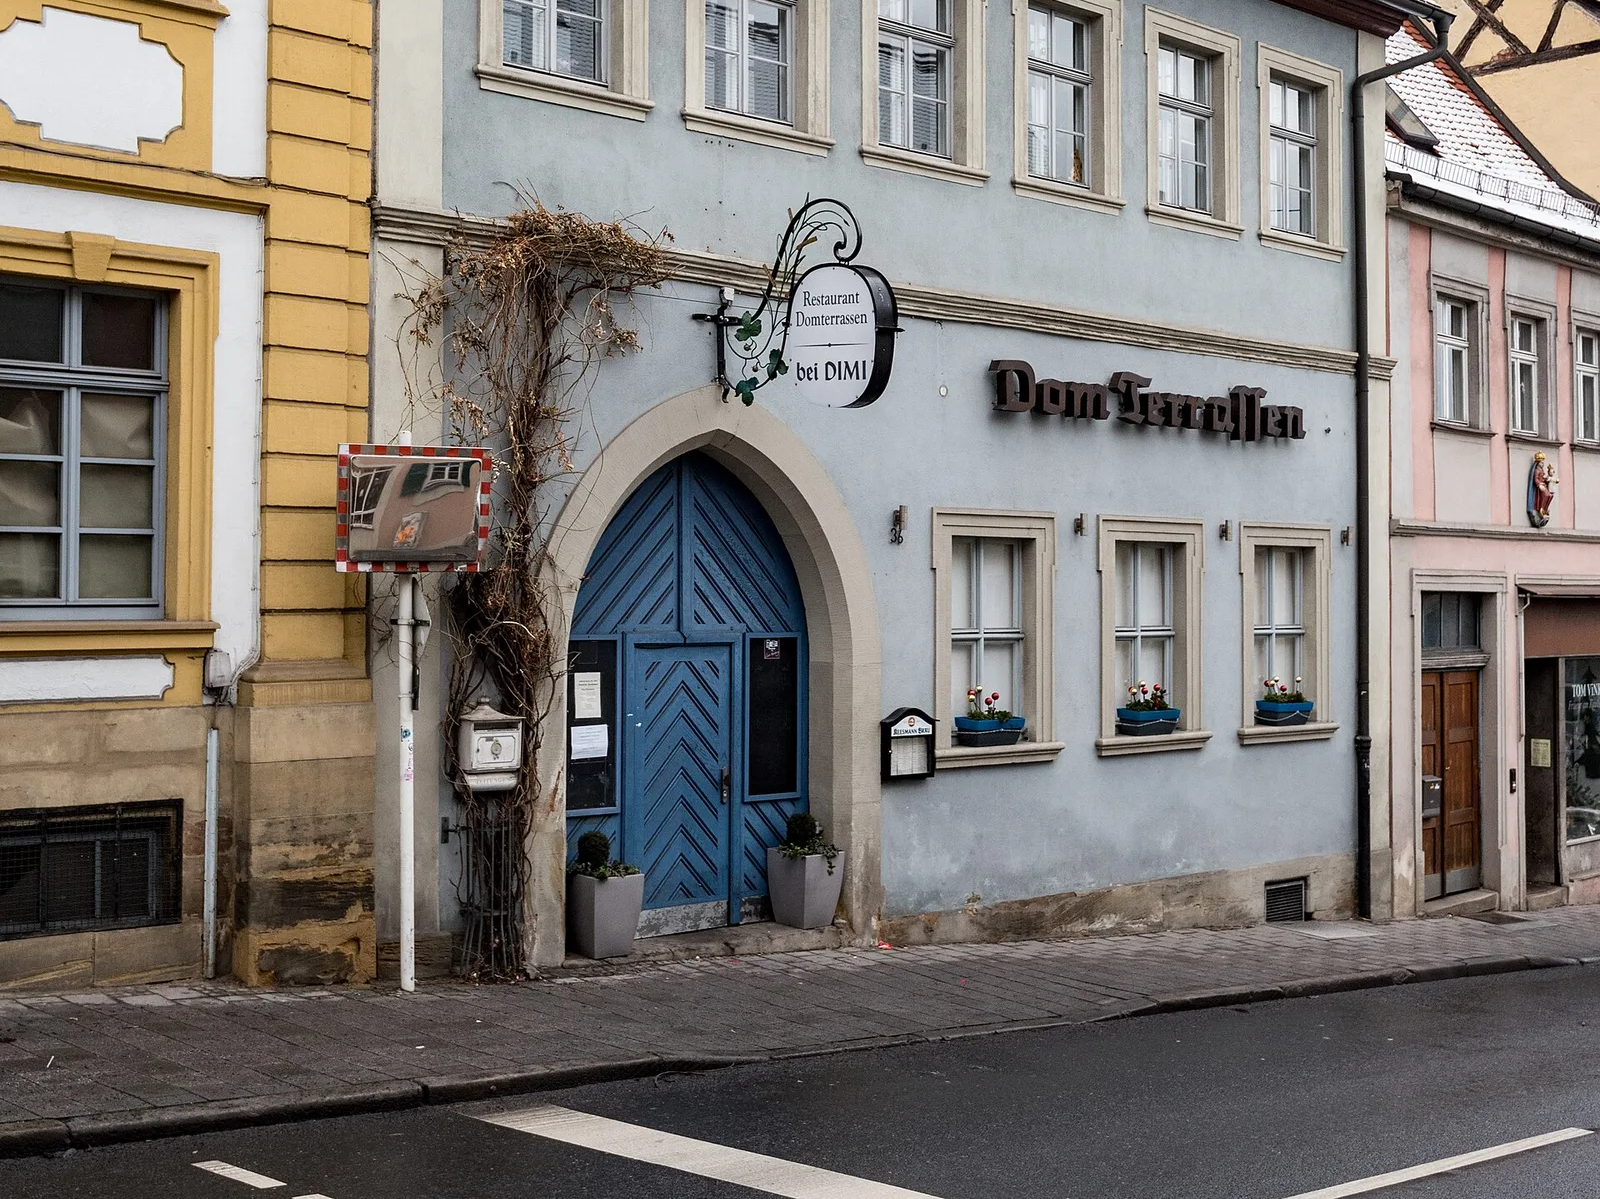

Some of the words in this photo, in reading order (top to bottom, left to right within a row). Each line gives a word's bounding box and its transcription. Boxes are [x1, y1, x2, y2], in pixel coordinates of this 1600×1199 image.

[803, 291, 860, 307] Restaurant
[796, 311, 868, 327] Domterrassen
[796, 362, 819, 381] bei
[825, 360, 867, 381] DIMI
[988, 359, 1110, 420] Dom
[890, 528, 904, 545] 36
[1572, 683, 1586, 697] TOM
